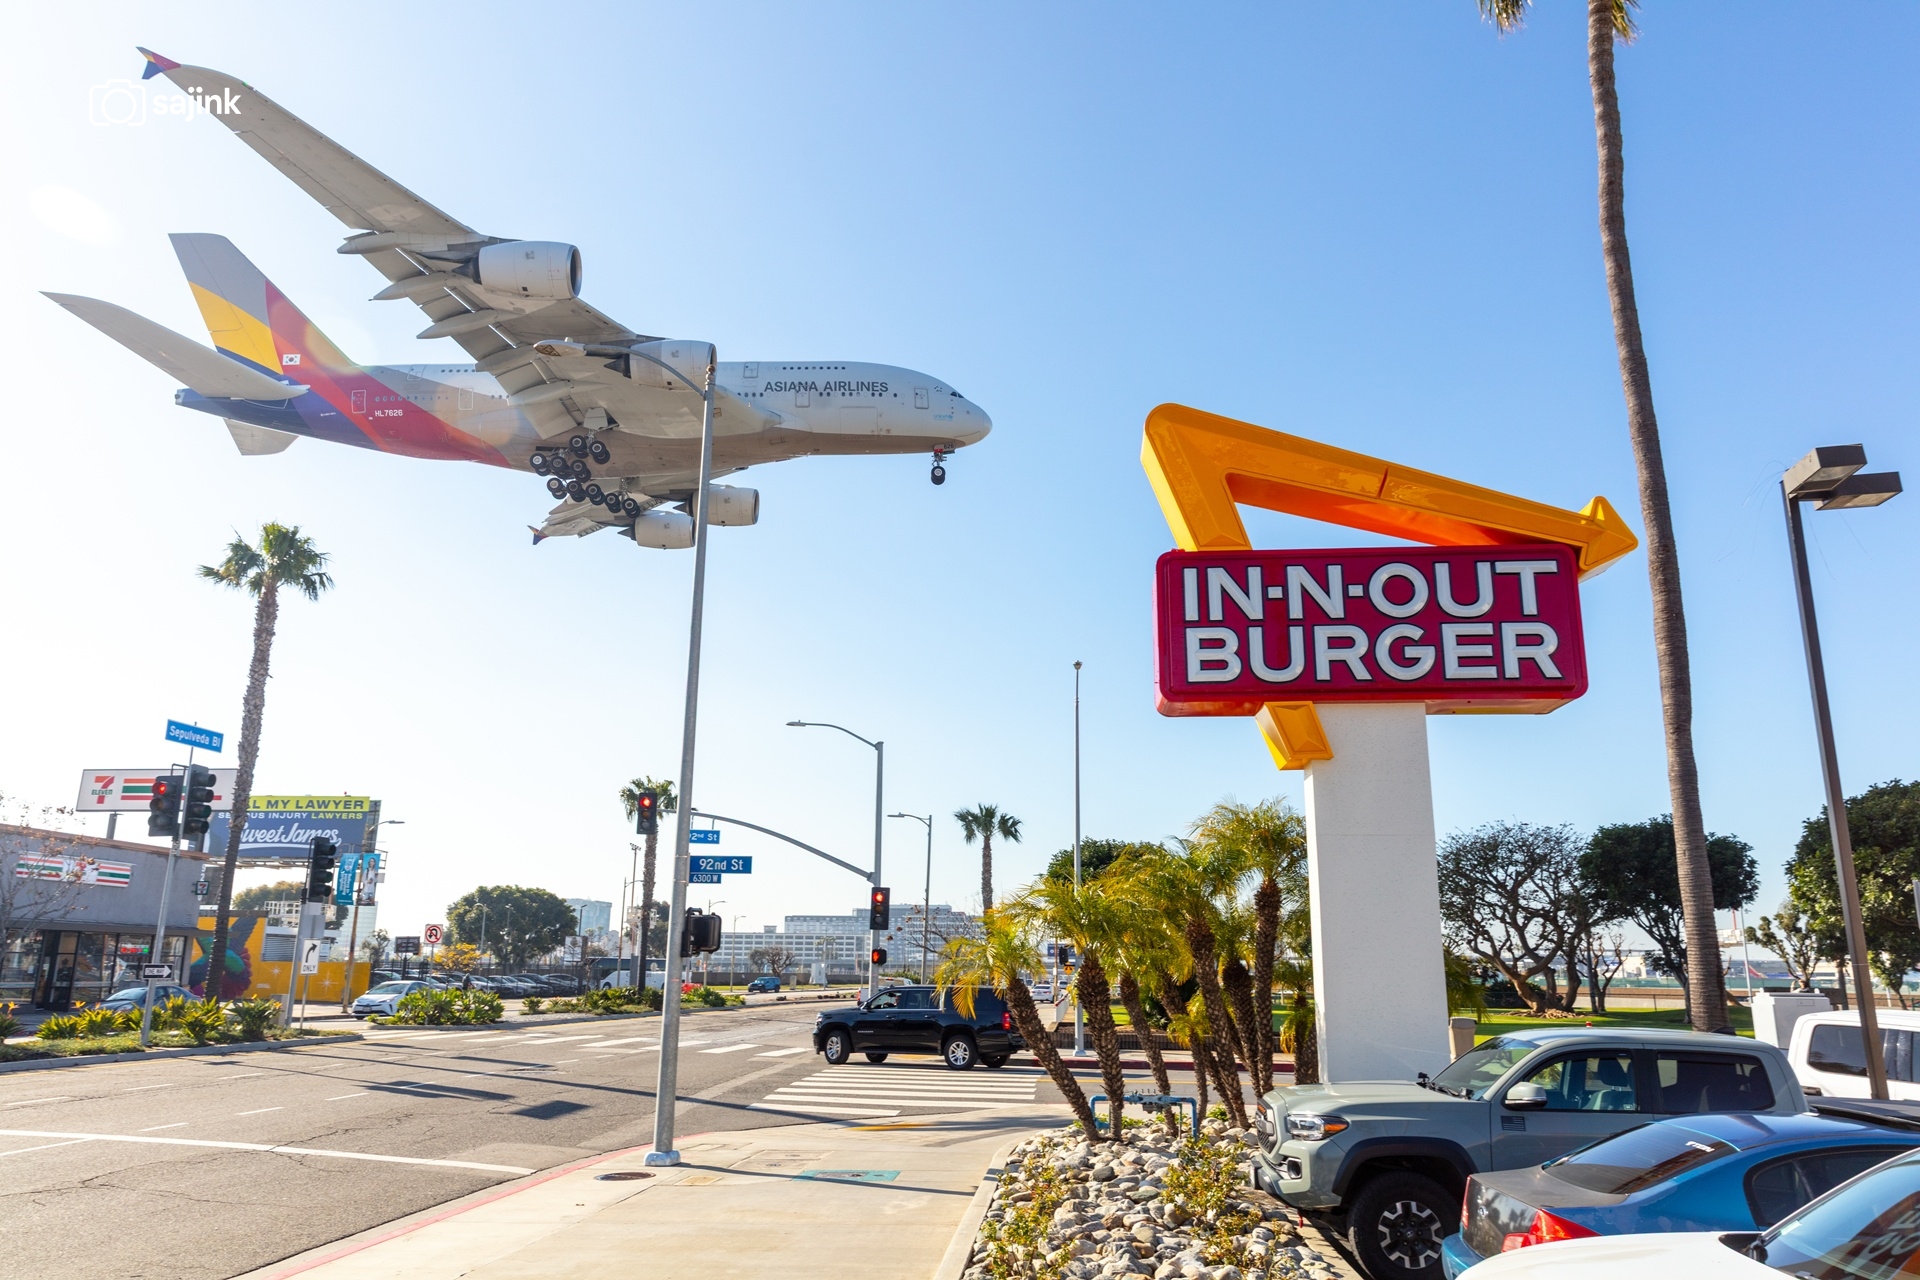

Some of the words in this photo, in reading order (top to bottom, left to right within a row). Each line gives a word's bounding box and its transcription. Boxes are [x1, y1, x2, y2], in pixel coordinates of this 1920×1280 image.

[764, 381, 819, 392] ASIANA
[823, 381, 889, 392] AIRLINES
[374, 409, 404, 417] HL7626
[1183, 559, 1558, 621] IN-N-OUT
[1185, 622, 1564, 684] BURGER
[169, 725, 210, 744] Sepulveda
[266, 799, 291, 809] MY
[295, 799, 364, 810] LAWYER
[707, 833, 718, 841] St
[699, 858, 727, 870] 92nd
[730, 858, 744, 871] St
[692, 874, 711, 883] 6300
[712, 874, 719, 882] W
[303, 964, 316, 972] ONLY
